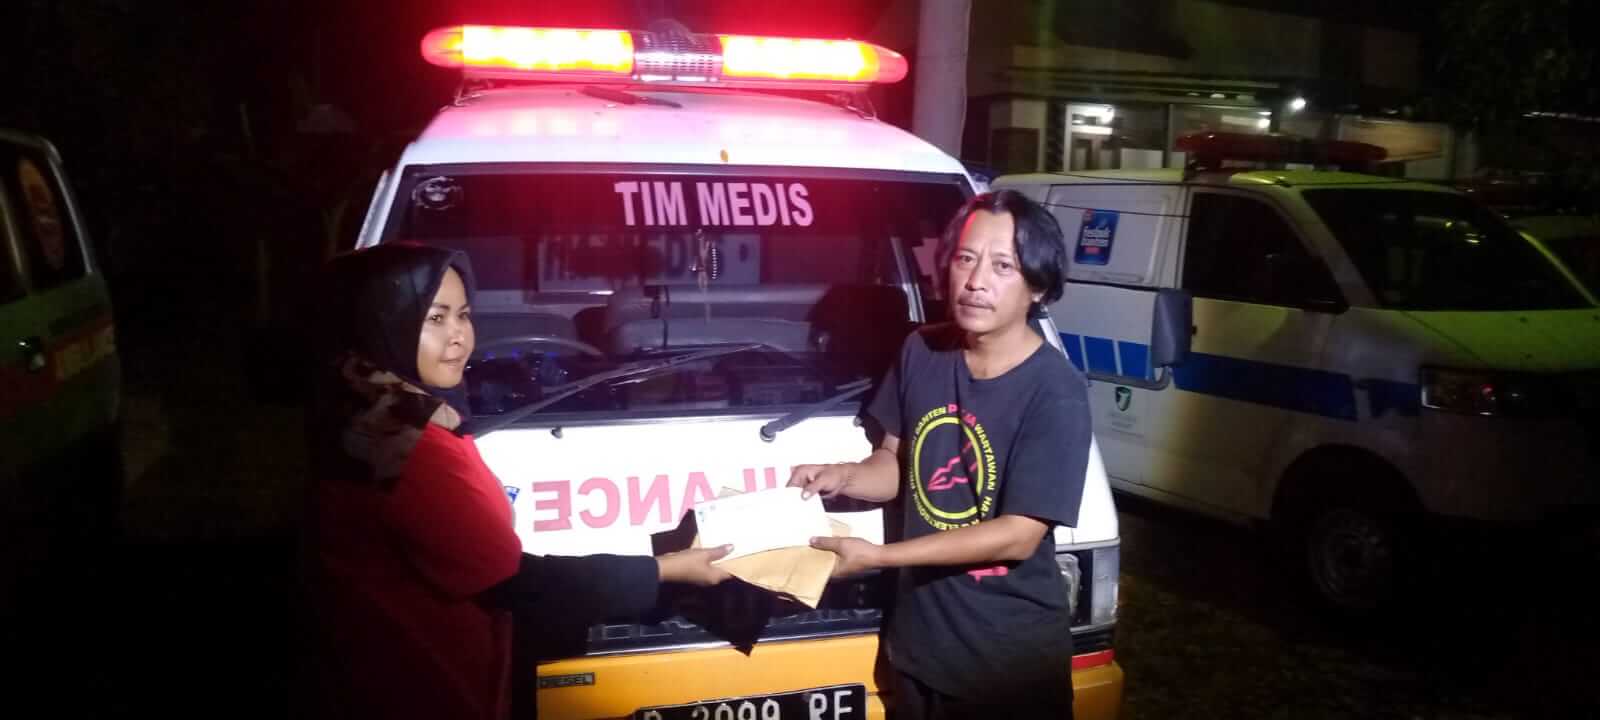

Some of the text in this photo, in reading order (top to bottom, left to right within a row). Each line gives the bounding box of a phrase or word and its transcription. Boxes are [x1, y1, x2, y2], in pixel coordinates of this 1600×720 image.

[614, 181, 814, 227] TIM MEDIS
[975, 423, 996, 490] WARTAWAN
